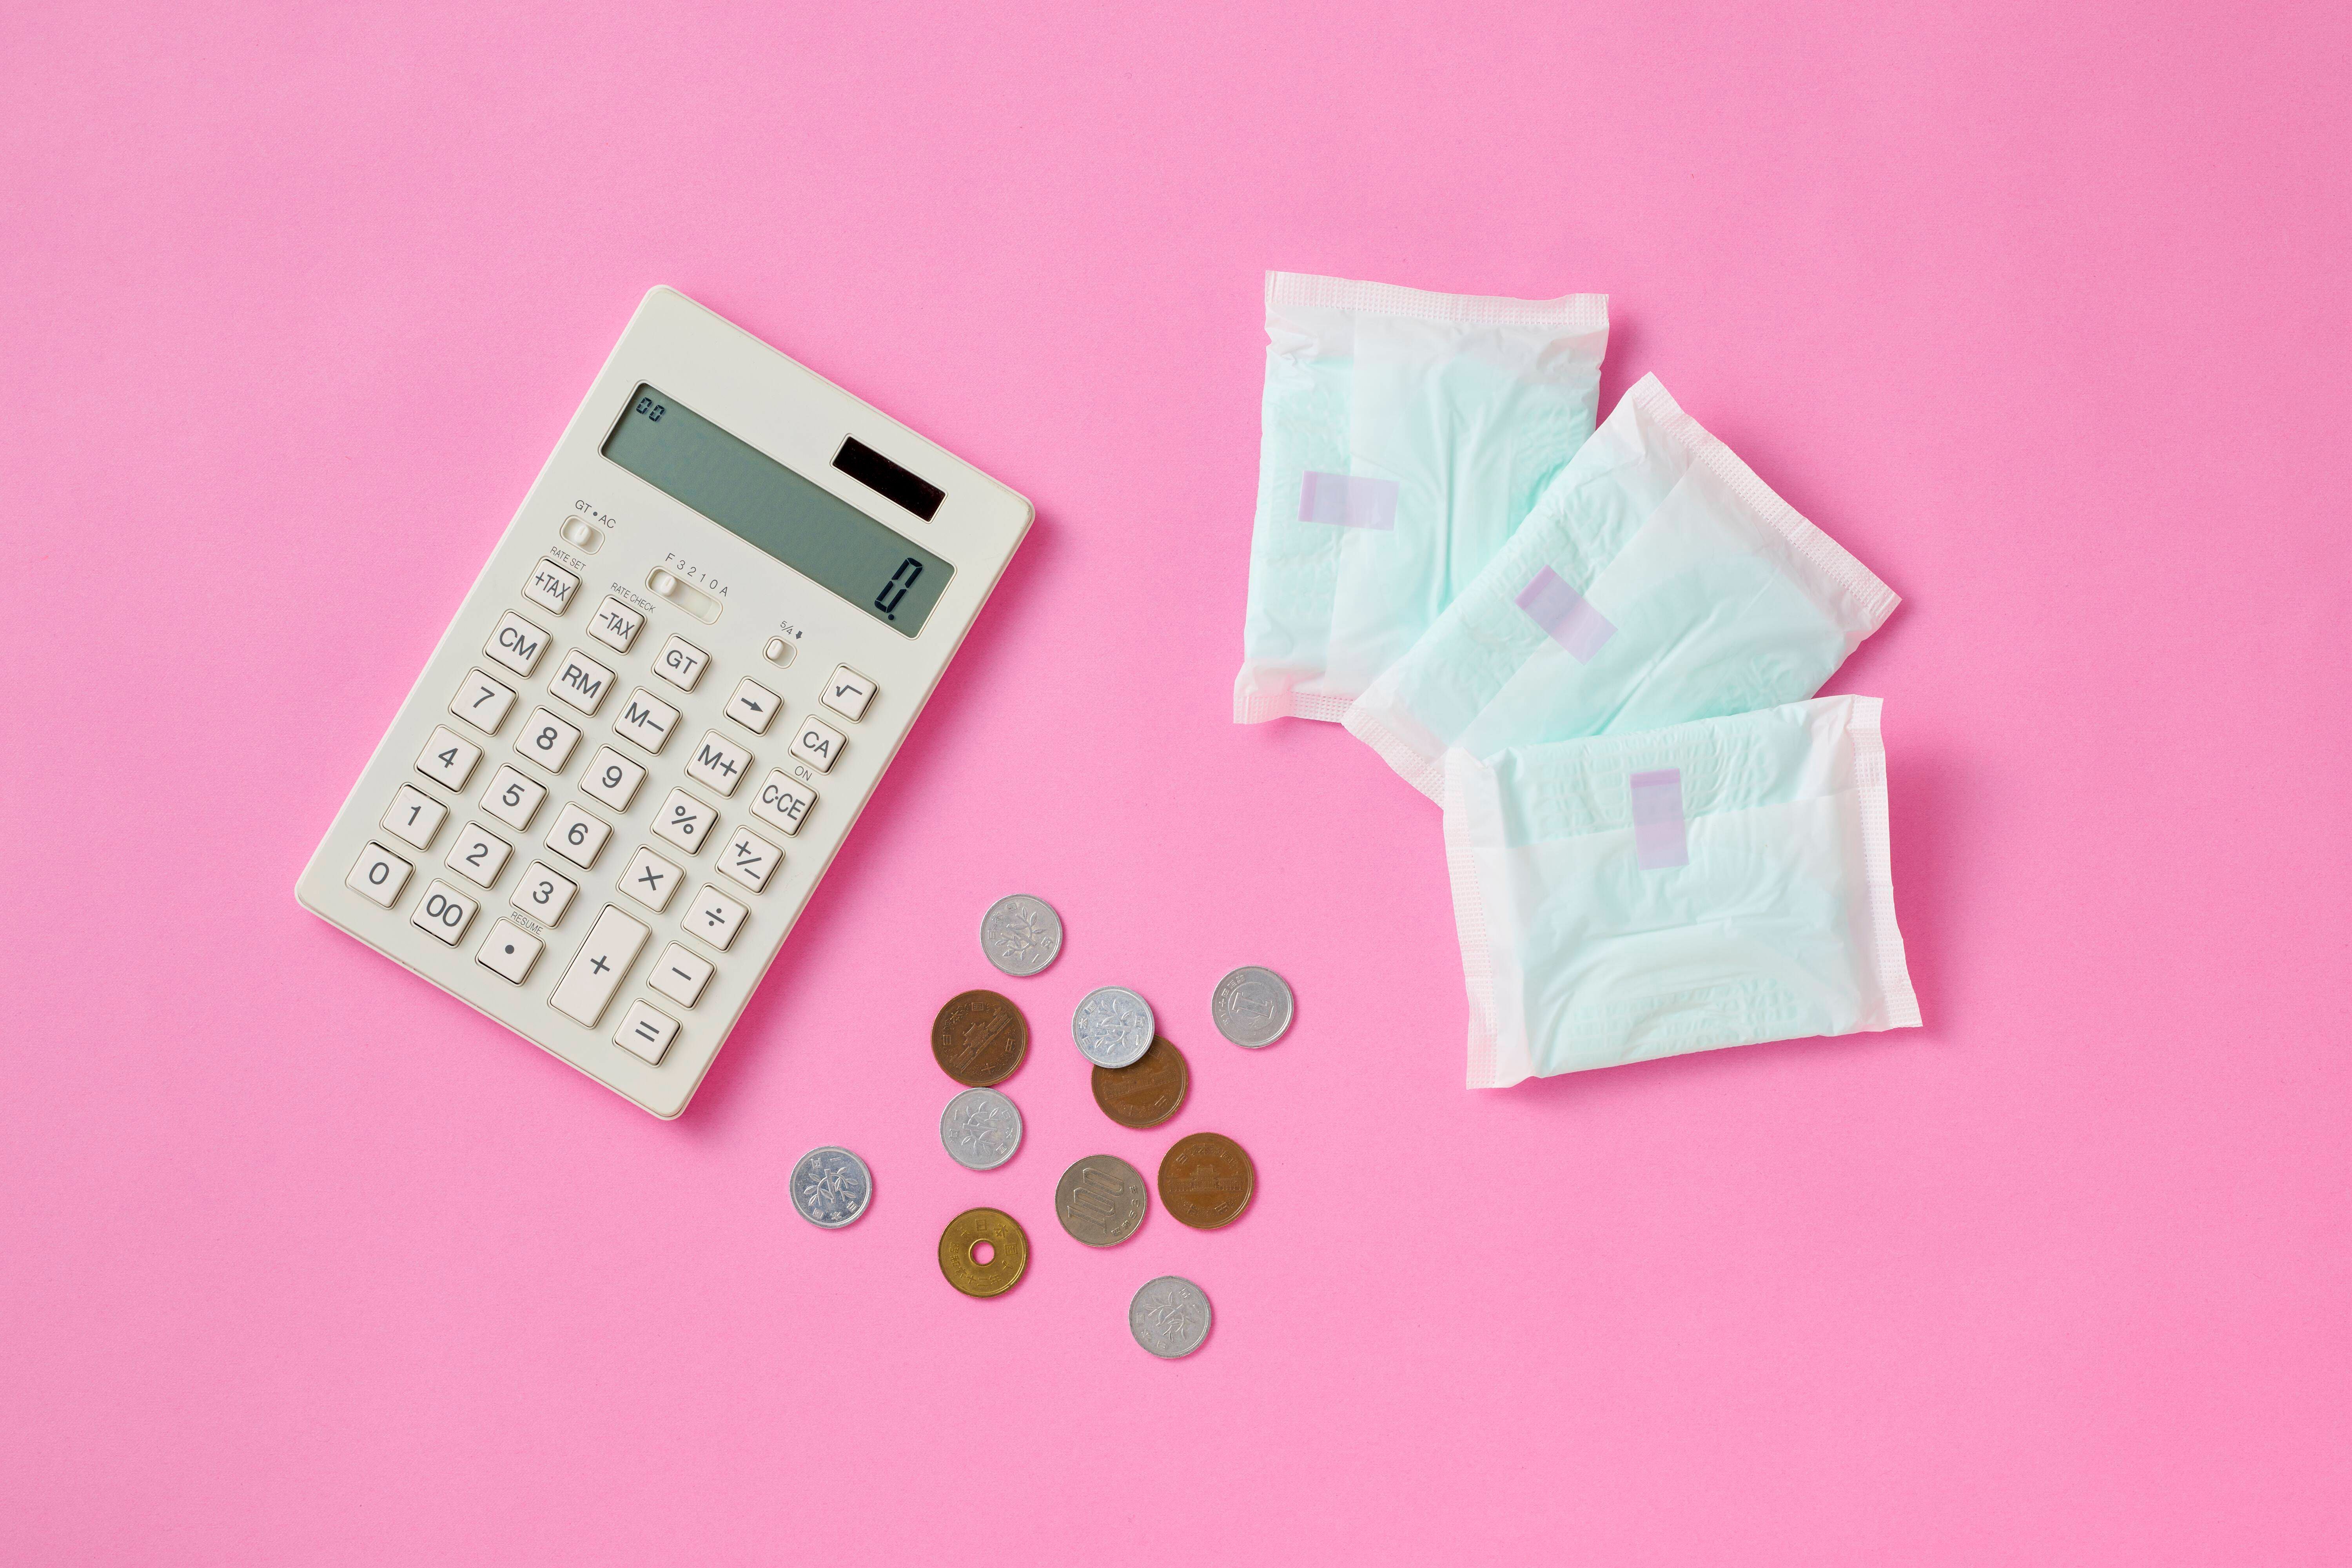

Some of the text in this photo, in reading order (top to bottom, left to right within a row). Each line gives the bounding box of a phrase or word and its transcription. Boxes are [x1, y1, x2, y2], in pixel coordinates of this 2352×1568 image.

[636, 397, 665, 422] 00
[575, 500, 592, 513] GT
[598, 514, 616, 528] AC
[550, 546, 586, 571] RATE SET
[535, 572, 571, 602] +TAX
[665, 553, 728, 597] F 3 2 1 0 A
[610, 582, 656, 613] RATE CHECK
[780, 621, 794, 635] 5/4
[499, 627, 538, 661] CM
[666, 650, 698, 674] GT
[561, 664, 602, 699] RM
[473, 686, 495, 708] 7
[536, 727, 558, 750] 8
[803, 731, 829, 759] CA
[438, 748, 458, 768] 4
[697, 744, 737, 777] M+
[602, 766, 622, 788] 9
[795, 766, 812, 781] ON
[503, 783, 525, 807] 5
[408, 806, 422, 826] 1
[568, 823, 588, 846] 6
[466, 843, 488, 867] 2
[369, 862, 389, 885] 0
[533, 881, 554, 904] 3
[426, 894, 463, 927] 00
[510, 911, 543, 935] RESUME
[1232, 990, 1274, 1019] 1
[1067, 1167, 1124, 1234] 100
